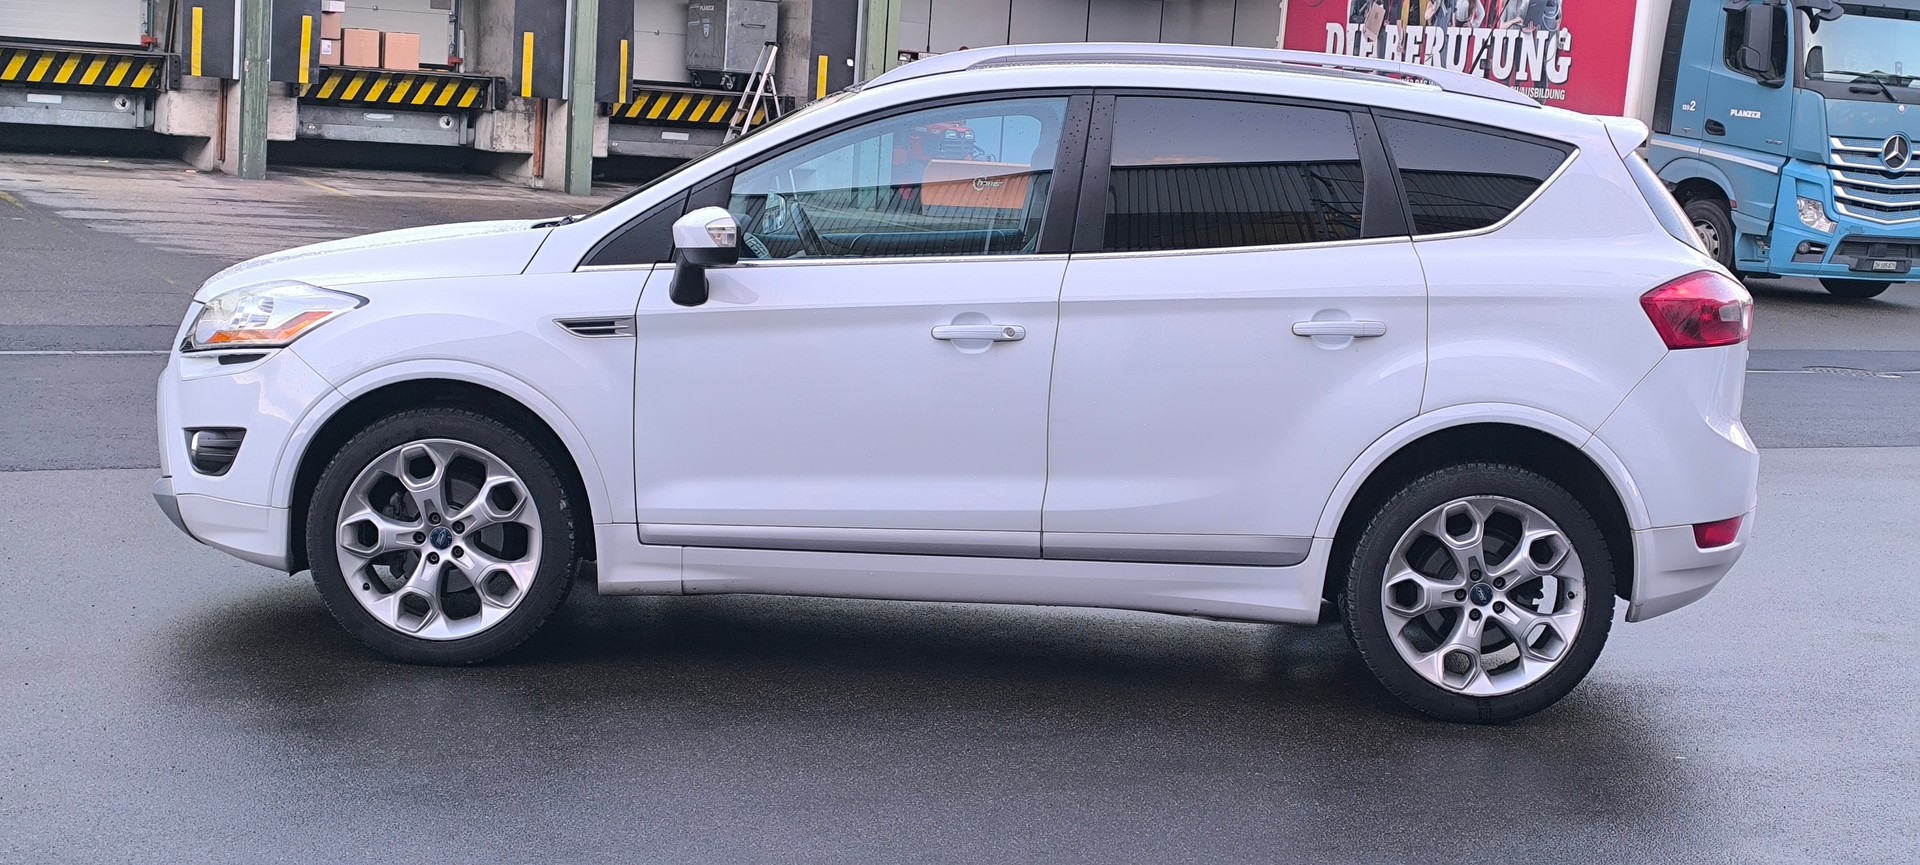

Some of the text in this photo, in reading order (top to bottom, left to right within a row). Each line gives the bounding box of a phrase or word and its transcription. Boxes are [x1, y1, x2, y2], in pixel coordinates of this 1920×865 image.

[1325, 22, 1572, 84] DIE BERUFUNG
[1730, 109, 1761, 118] PLANZER
